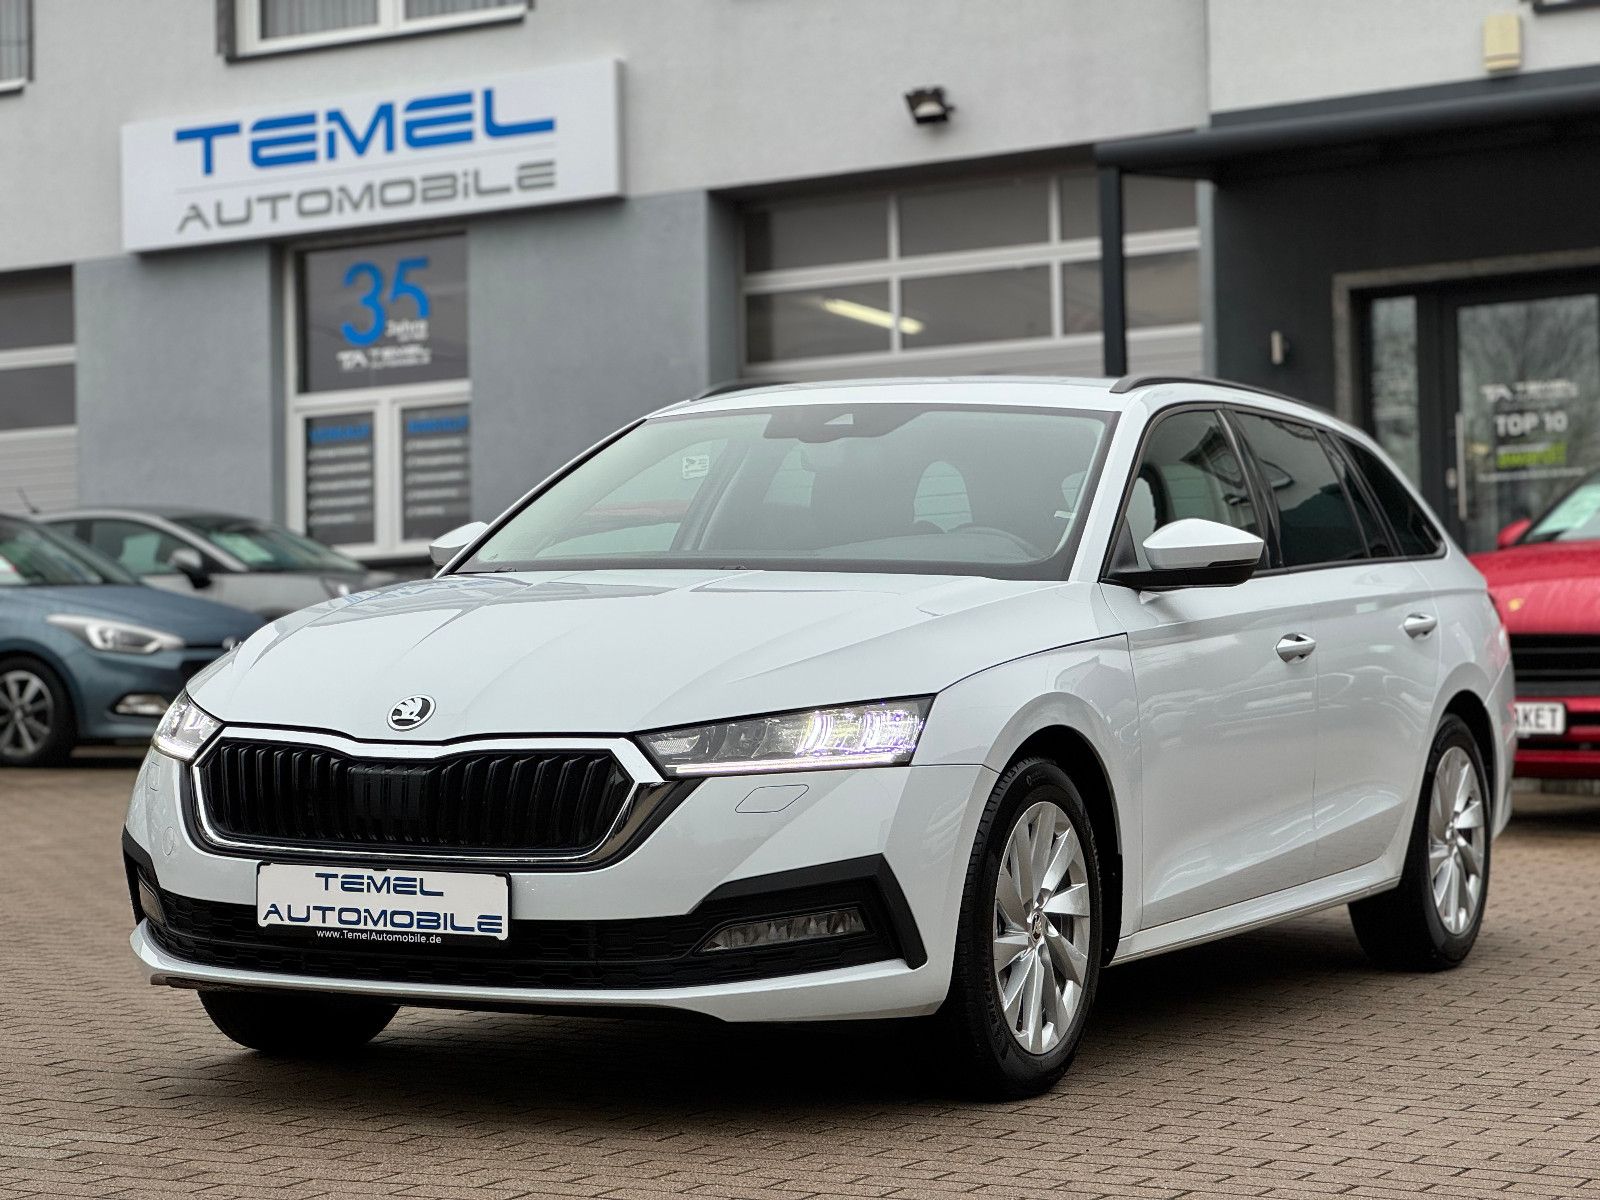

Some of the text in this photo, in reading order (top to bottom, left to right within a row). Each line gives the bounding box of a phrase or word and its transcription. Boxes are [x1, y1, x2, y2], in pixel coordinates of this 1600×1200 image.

[175, 87, 556, 176] TEMEL
[340, 256, 431, 347] 35
[1494, 410, 1568, 437] TOP 10
[1514, 706, 1558, 729] KET
[315, 872, 444, 897] TEMEL
[263, 903, 502, 933] AUTOMOBILE
[316, 929, 442, 944] www.TemelAutomobile.de
